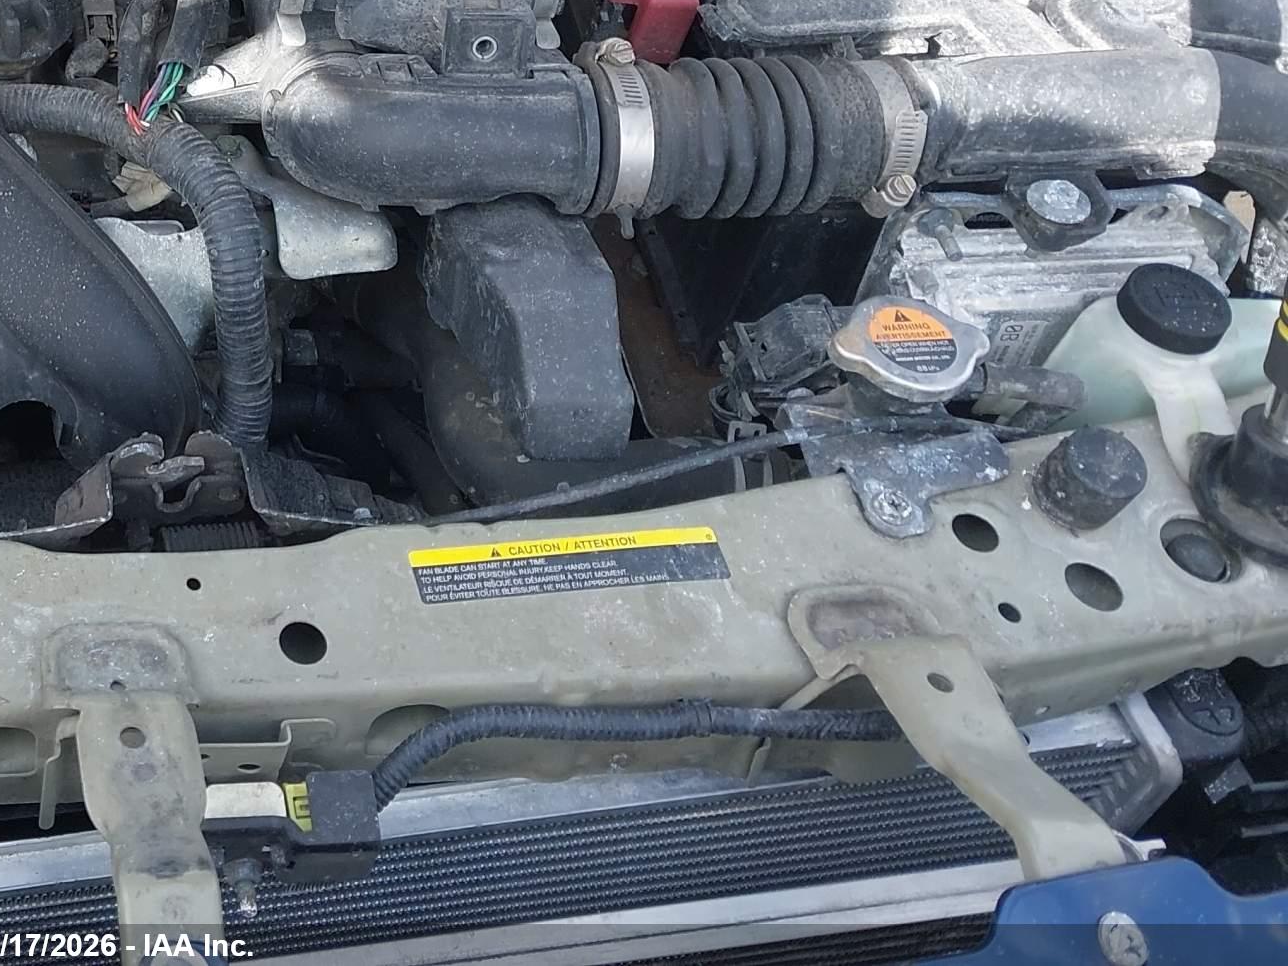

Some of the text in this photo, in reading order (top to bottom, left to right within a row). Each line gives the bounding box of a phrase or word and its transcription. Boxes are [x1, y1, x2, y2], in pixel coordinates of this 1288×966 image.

[875, 330, 946, 340] AVERTISSEMENT
[881, 322, 931, 332] WARNING
[508, 542, 561, 556] CAUTION
[574, 535, 637, 550] ATTENTION
[418, 567, 434, 575] FAN
[434, 565, 460, 575] BLADE
[460, 563, 477, 572] CAN
[478, 561, 501, 571] START
[502, 560, 511, 569] AT
[512, 559, 528, 568] ANY
[421, 576, 432, 584] TO
[433, 574, 452, 583] HELP
[454, 572, 477, 582] AVOID
[478, 569, 518, 580] PERSONAL
[564, 561, 591, 571] HANDS
[424, 585, 433, 594] LE
[434, 581, 482, 593] VENTILATEUR
[483, 578, 513, 589] RISQUE
[514, 577, 524, 586] DE
[525, 573, 565, 584] DÉMARRER
[574, 571, 594, 580] TOUT
[426, 592, 449, 602] POUR
[449, 589, 475, 601] ÉVITER
[543, 583, 554, 592] NE
[555, 581, 571, 590] PAS
[571, 580, 583, 589] EN
[583, 576, 630, 588] APPROCHER
[630, 574, 645, 584] LES
